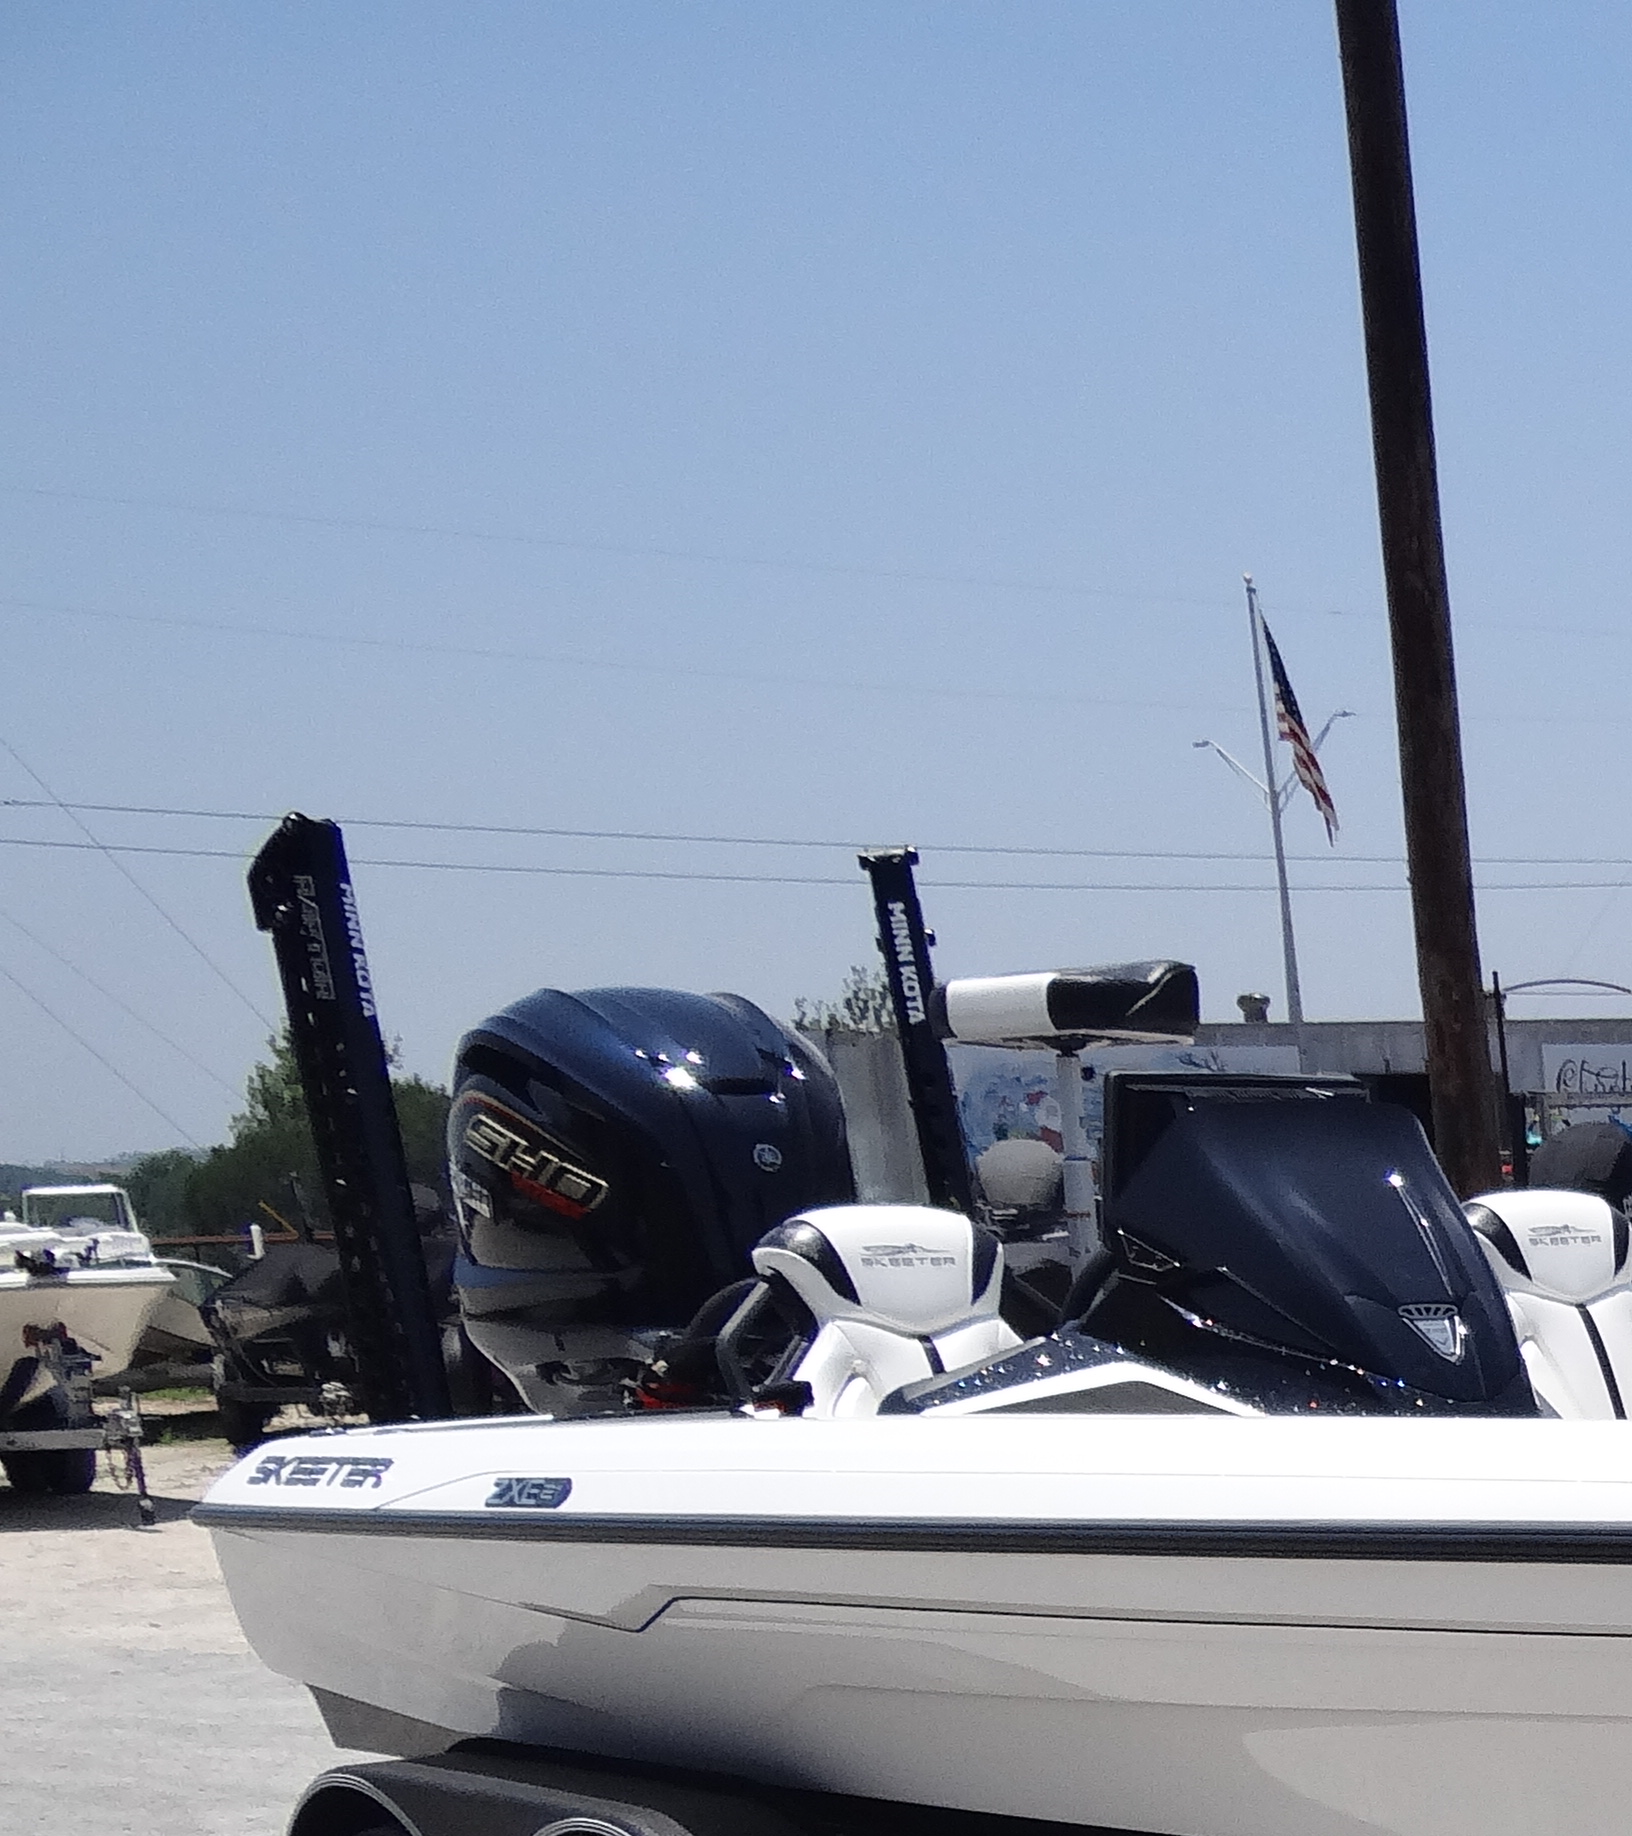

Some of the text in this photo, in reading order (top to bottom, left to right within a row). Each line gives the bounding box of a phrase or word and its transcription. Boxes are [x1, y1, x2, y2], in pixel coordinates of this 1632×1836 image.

[340, 883, 375, 1017] MINN KOTA
[887, 901, 926, 1025] MINN KOTA
[1528, 1235, 1602, 1247] SKEETER
[861, 1257, 956, 1268] SKEETER
[247, 1456, 395, 1488] SKEETER
